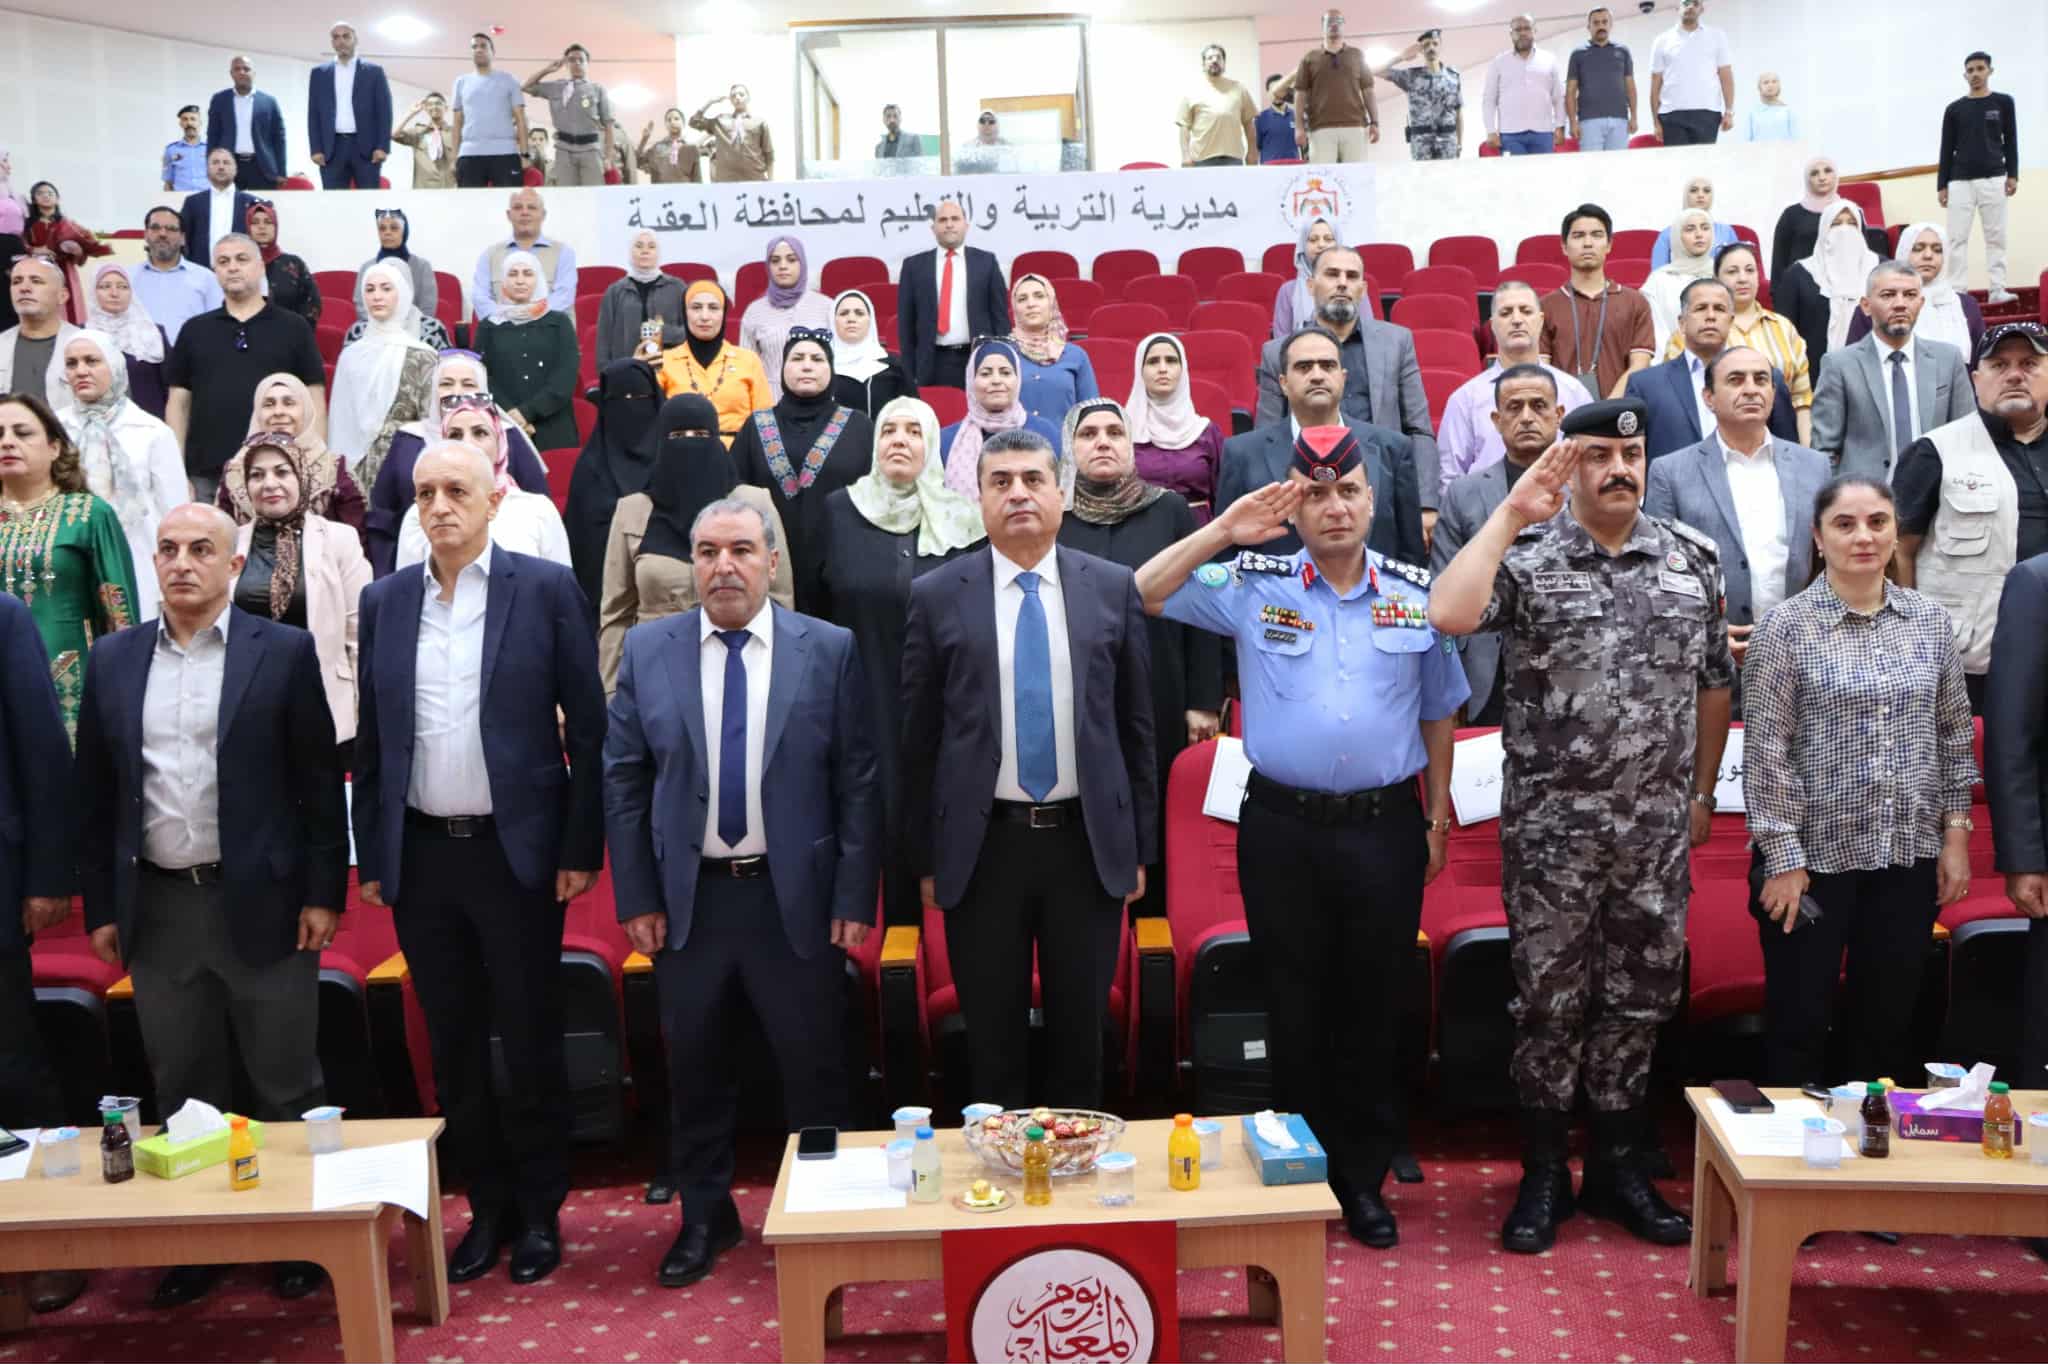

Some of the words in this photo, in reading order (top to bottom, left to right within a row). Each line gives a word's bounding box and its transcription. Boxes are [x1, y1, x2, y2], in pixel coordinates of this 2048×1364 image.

[733, 192, 866, 228] لمحافظة
[1013, 184, 1116, 231] التربية
[1131, 185, 1238, 231] مديرية
[1006, 1285, 1138, 1364] المعل
